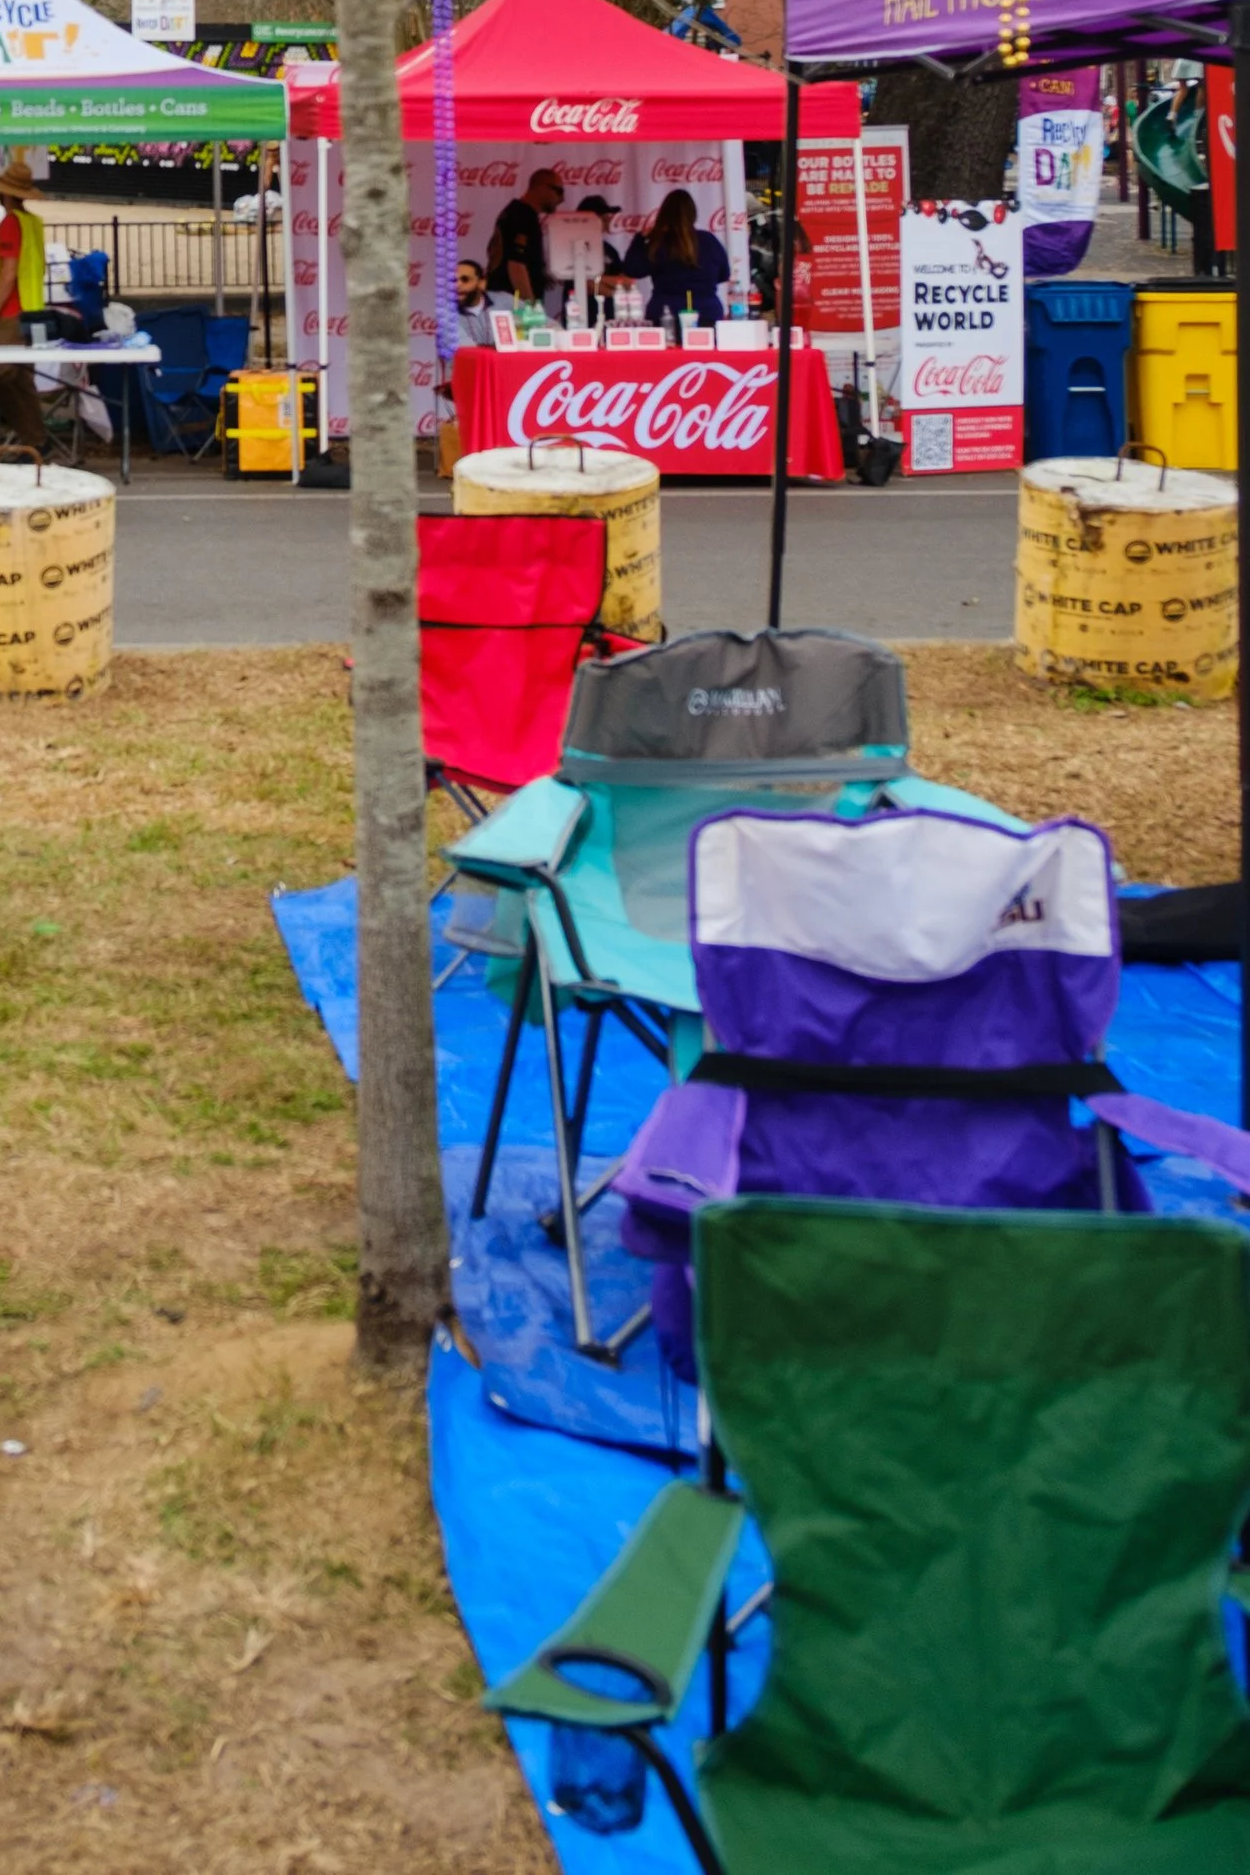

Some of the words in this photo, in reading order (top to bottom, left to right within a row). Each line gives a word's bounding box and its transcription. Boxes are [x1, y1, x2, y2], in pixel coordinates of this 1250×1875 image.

[10, 98, 66, 118] Beads
[80, 97, 146, 118] Bottles
[160, 97, 209, 116] Cans
[530, 96, 644, 134] Coca-Cola
[798, 156, 830, 169] OUR
[798, 170, 828, 182] ARE
[876, 168, 896, 180] TO
[806, 183, 825, 195] BE
[914, 264, 955, 274] WELCOME
[914, 282, 1009, 305] RECYCLE
[913, 311, 995, 331] WORLD
[913, 354, 1009, 398] Coca-Cola
[507, 360, 779, 450] Coca-Cola
[1155, 536, 1216, 555] WHITE
[1038, 591, 1092, 612] WHITE
[1099, 600, 1142, 616] CAP
[1136, 660, 1179, 675] CAP
